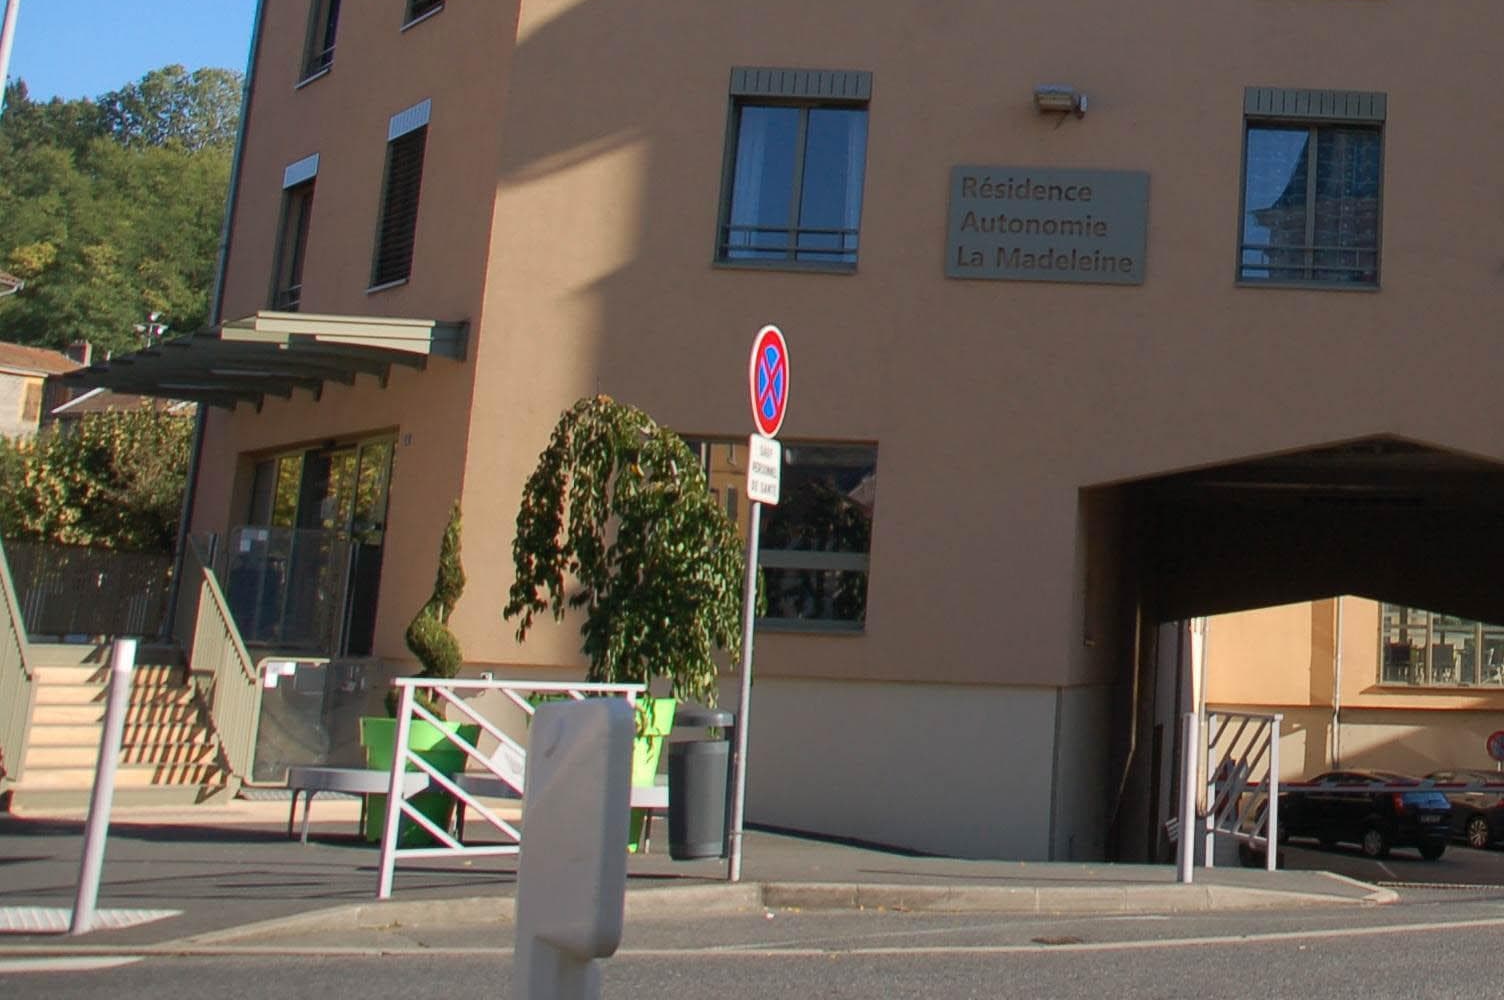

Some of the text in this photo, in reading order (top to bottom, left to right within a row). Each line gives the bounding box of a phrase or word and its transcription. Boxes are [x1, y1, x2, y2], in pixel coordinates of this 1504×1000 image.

[961, 176, 1092, 202] Résidence
[960, 211, 1108, 238] Autonomie
[957, 246, 1133, 273] La Madeleine
